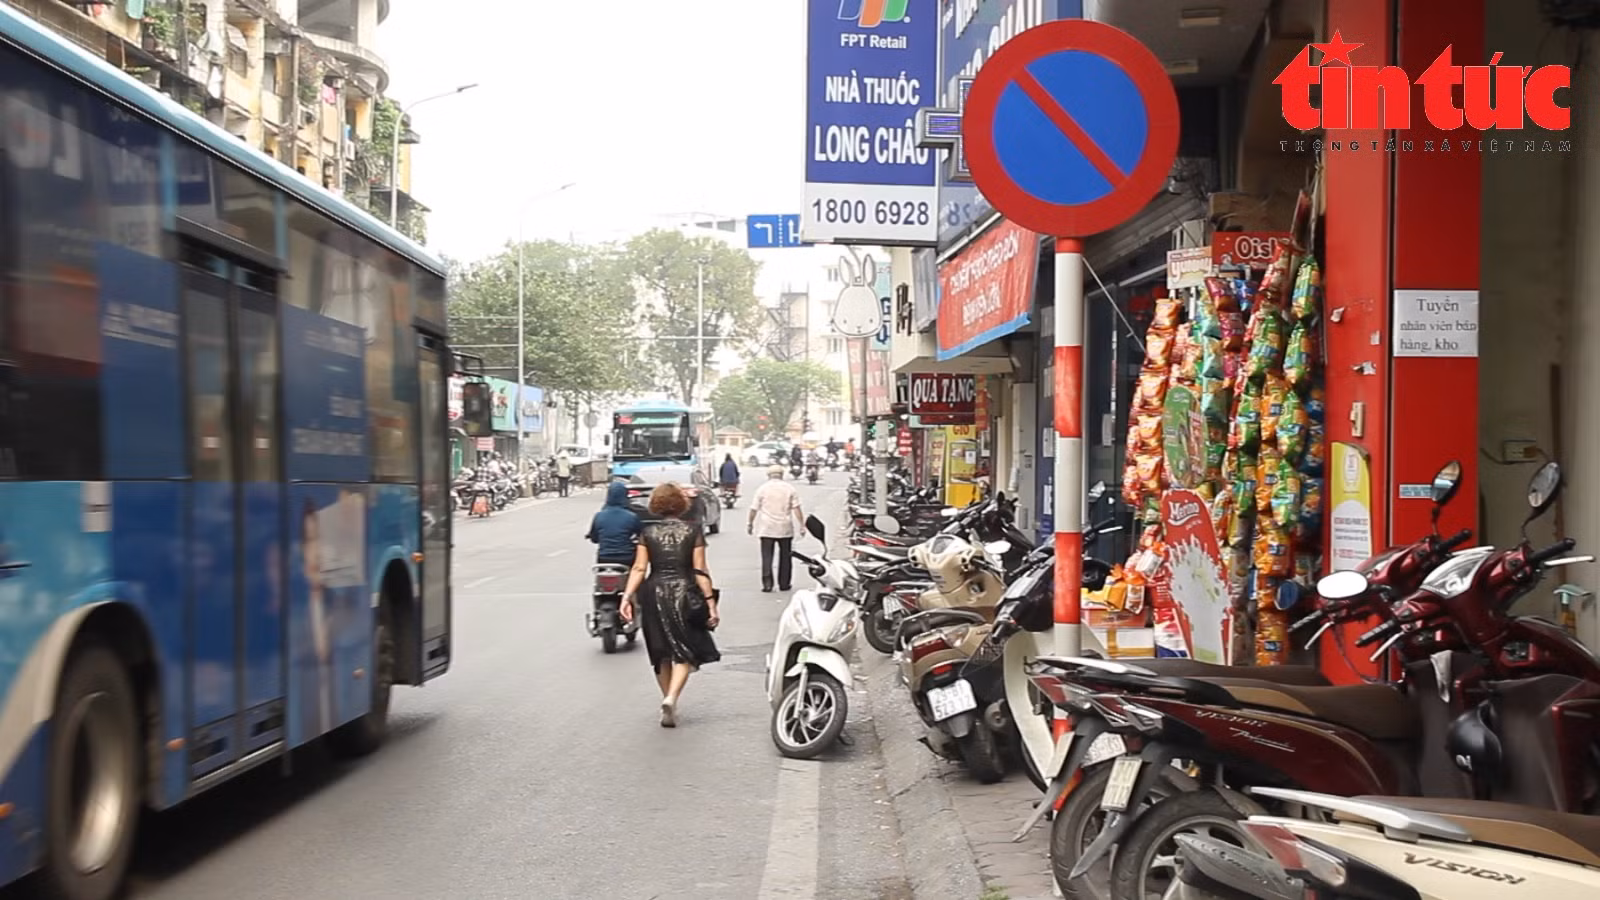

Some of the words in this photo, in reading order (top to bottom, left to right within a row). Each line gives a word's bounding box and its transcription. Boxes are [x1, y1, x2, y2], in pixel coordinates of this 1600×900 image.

[841, 34, 867, 47] FPT
[870, 34, 907, 48] Retail
[825, 69, 861, 103] NHÀ
[863, 70, 920, 105] THUỐC
[815, 125, 870, 162] LONG
[813, 198, 866, 223] 1800
[875, 200, 929, 225] 6928
[1235, 236, 1279, 259] Ois
[1416, 296, 1459, 314] Tuyển
[1399, 320, 1426, 331] nhân
[1429, 320, 1452, 331] viên
[1435, 338, 1458, 350] kho
[1403, 852, 1527, 885] VISION
